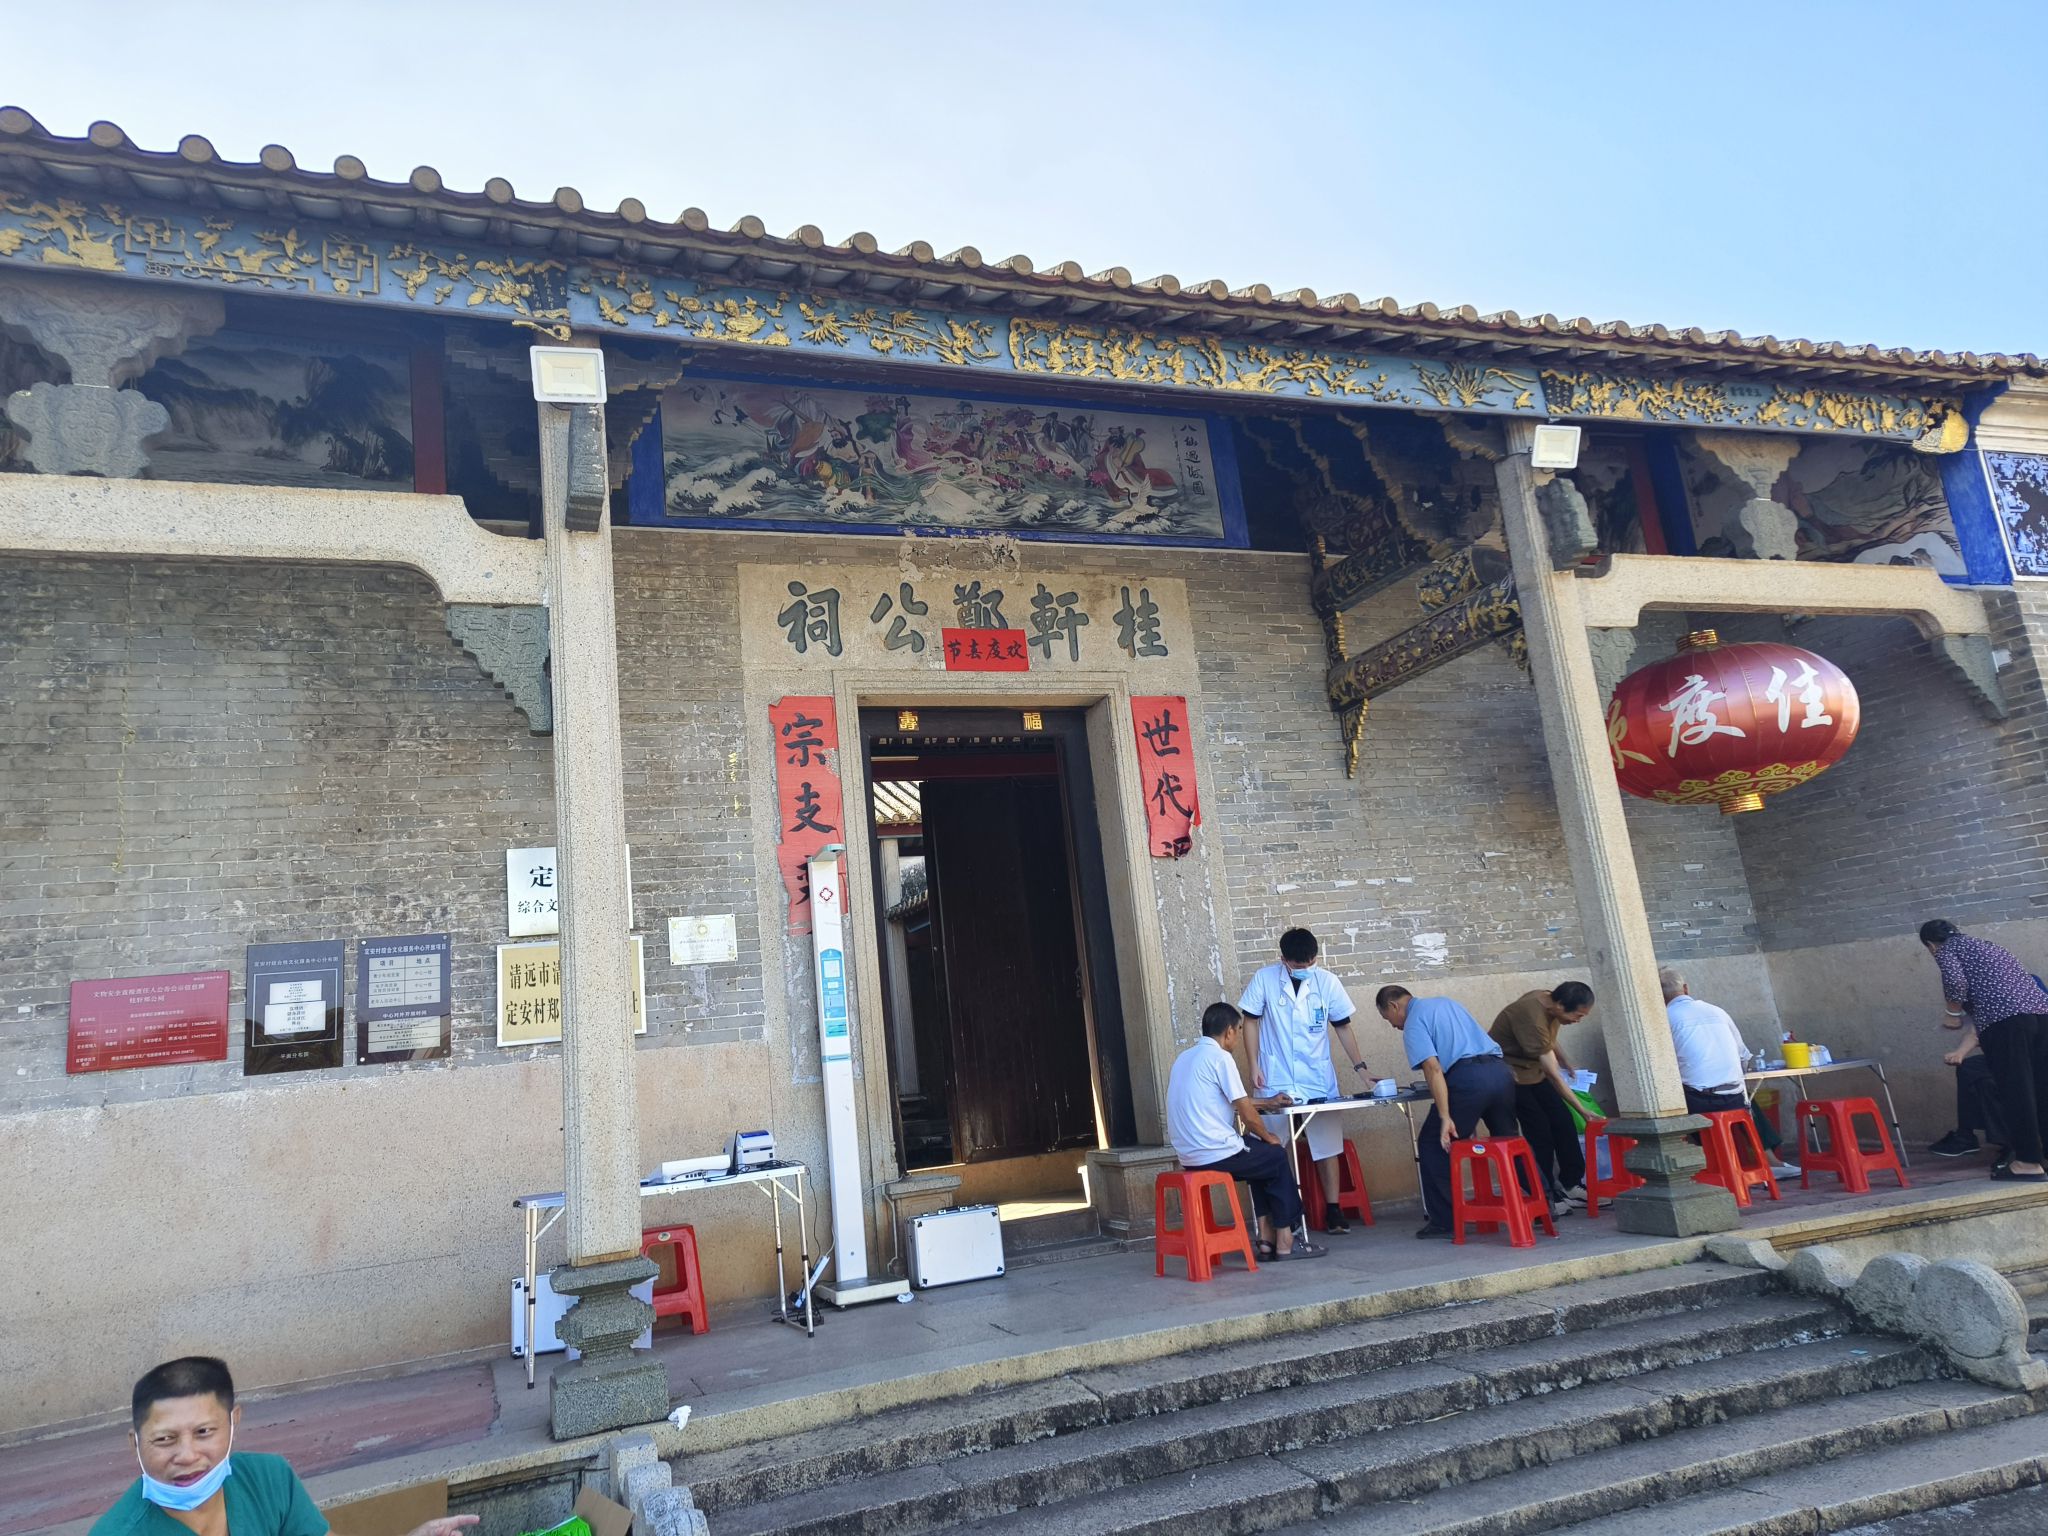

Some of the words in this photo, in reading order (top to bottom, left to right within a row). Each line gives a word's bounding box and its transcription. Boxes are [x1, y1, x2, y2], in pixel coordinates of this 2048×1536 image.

[1023, 712, 1043, 731] 福
[529, 865, 554, 888] 定
[517, 898, 558, 914] 综合文
